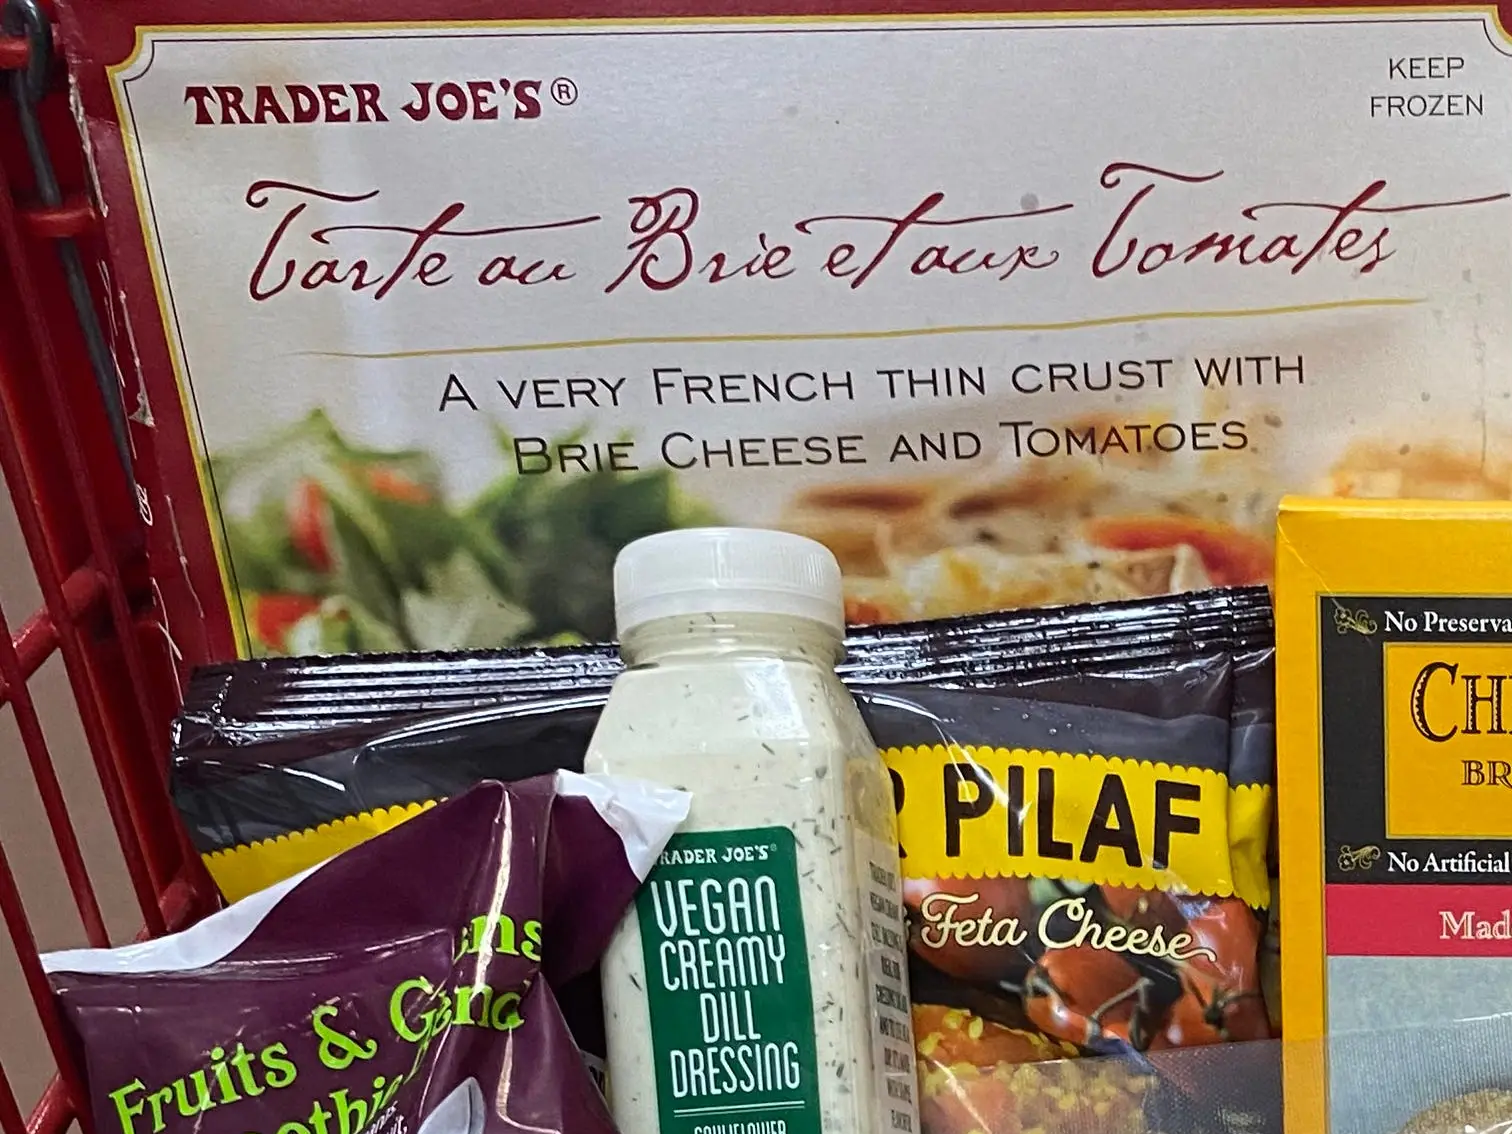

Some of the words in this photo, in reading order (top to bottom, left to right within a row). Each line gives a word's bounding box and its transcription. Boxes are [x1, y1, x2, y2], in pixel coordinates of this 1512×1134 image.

[1388, 56, 1464, 79] KEEP
[185, 85, 388, 125] TRADER
[1369, 94, 1484, 117] FROZEN
[246, 180, 475, 300] Tarte
[478, 253, 576, 286] au
[605, 186, 796, 294] Brie
[911, 239, 1060, 281] aux
[1090, 162, 1403, 278] Tomates
[439, 373, 478, 411] A
[498, 377, 625, 409] VERY
[652, 368, 854, 404] FRENCH
[877, 367, 985, 398] THIN
[1011, 360, 1172, 394] CRUST
[1194, 355, 1305, 385] WITH
[514, 436, 639, 475] BRIE
[660, 431, 867, 471] CHEESE
[888, 432, 981, 463] AND
[1000, 420, 1248, 458] TOMATOES
[1384, 611, 1418, 633] No
[945, 765, 1202, 871] PILAF
[1388, 851, 1419, 874] No
[652, 875, 780, 936] VEGAN
[921, 891, 1028, 949] Feta
[1039, 897, 1218, 962] Cheese
[660, 934, 787, 991] CREAMY
[311, 1005, 378, 1070] &
[701, 991, 762, 1041] DILL
[671, 1043, 801, 1098] DRESSING
